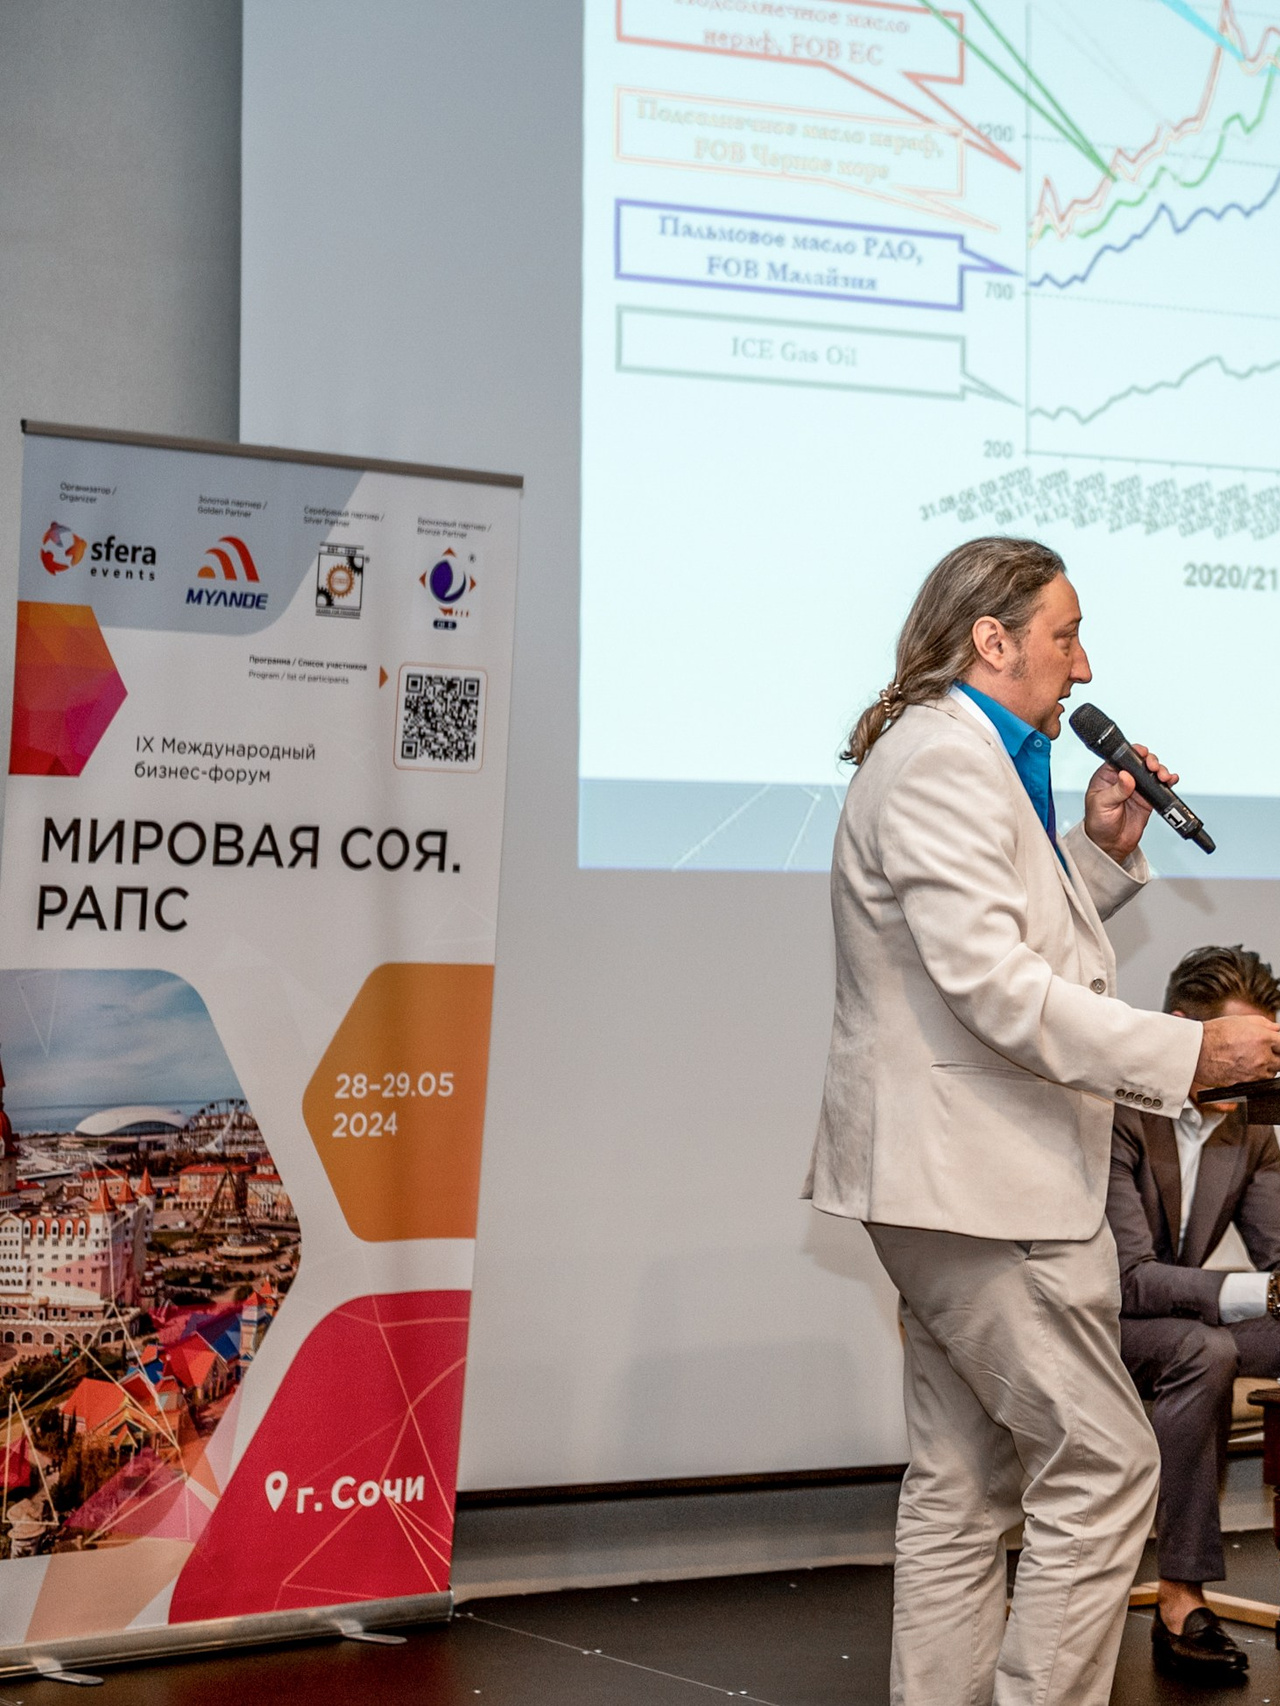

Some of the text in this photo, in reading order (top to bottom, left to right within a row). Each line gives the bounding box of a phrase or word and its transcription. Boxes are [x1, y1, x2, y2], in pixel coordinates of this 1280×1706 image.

[846, 12, 911, 34] масло
[790, 33, 841, 60] FOB
[636, 96, 798, 136] Подсолнечное
[803, 123, 865, 144] масло
[694, 136, 890, 184] FOB Черное море
[659, 213, 786, 249] Пальмовое
[791, 227, 857, 256] масло
[706, 253, 879, 292] FOB Малайзия
[984, 280, 1015, 301] 700
[731, 336, 858, 367] ICE Gas Oil
[983, 440, 1013, 459] 200
[59, 492, 97, 504] Organizer
[197, 505, 252, 518] Golden Partner
[91, 535, 157, 566] sfera
[90, 567, 156, 582] events
[1183, 562, 1279, 592] 2020/21
[186, 587, 269, 611] MYANDE
[248, 670, 280, 682] Program
[299, 673, 307, 682] of
[298, 658, 324, 669] Список
[136, 735, 316, 761] IX Международный
[134, 761, 271, 786] бизнес-форум
[1168, 813, 1183, 827] 1
[41, 816, 462, 874] МИРОВАЯ СОЯ.
[36, 885, 190, 932] РАПС
[334, 1072, 455, 1099] 28-29.05
[332, 1112, 398, 1138] 2024
[296, 1474, 425, 1514] г. Сочи
